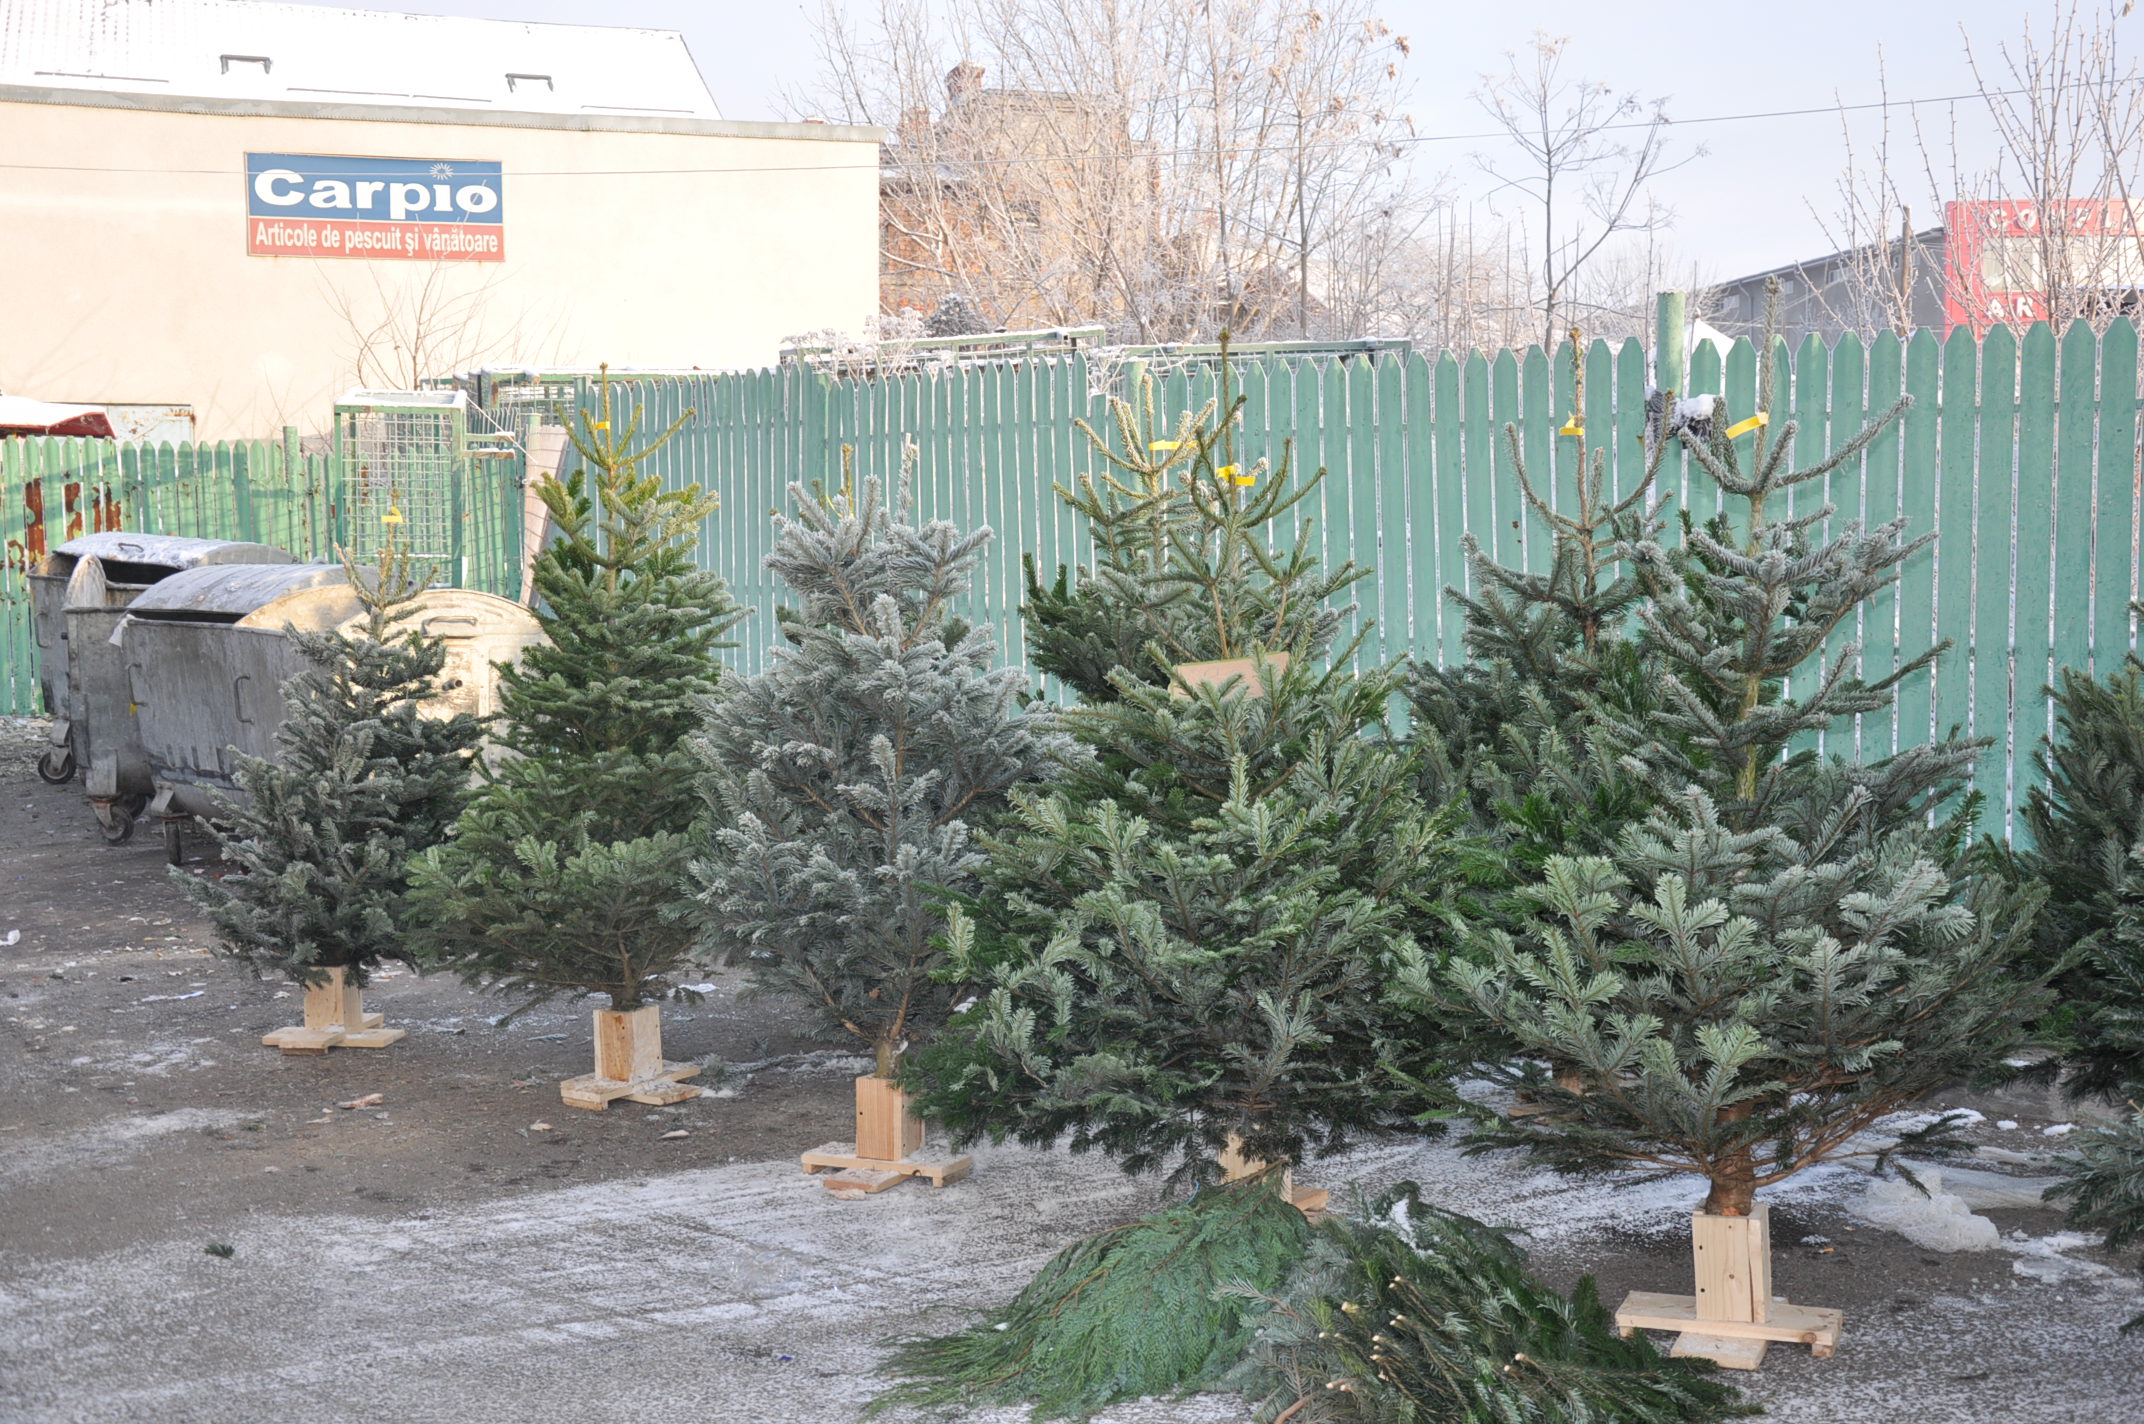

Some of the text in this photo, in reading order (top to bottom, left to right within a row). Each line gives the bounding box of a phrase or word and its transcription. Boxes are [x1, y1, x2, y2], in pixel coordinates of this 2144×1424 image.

[254, 163, 498, 219] Carpio
[255, 221, 317, 247] Articole
[321, 223, 341, 249] de
[345, 226, 402, 254] pescuit
[423, 227, 499, 253] vânătoare
